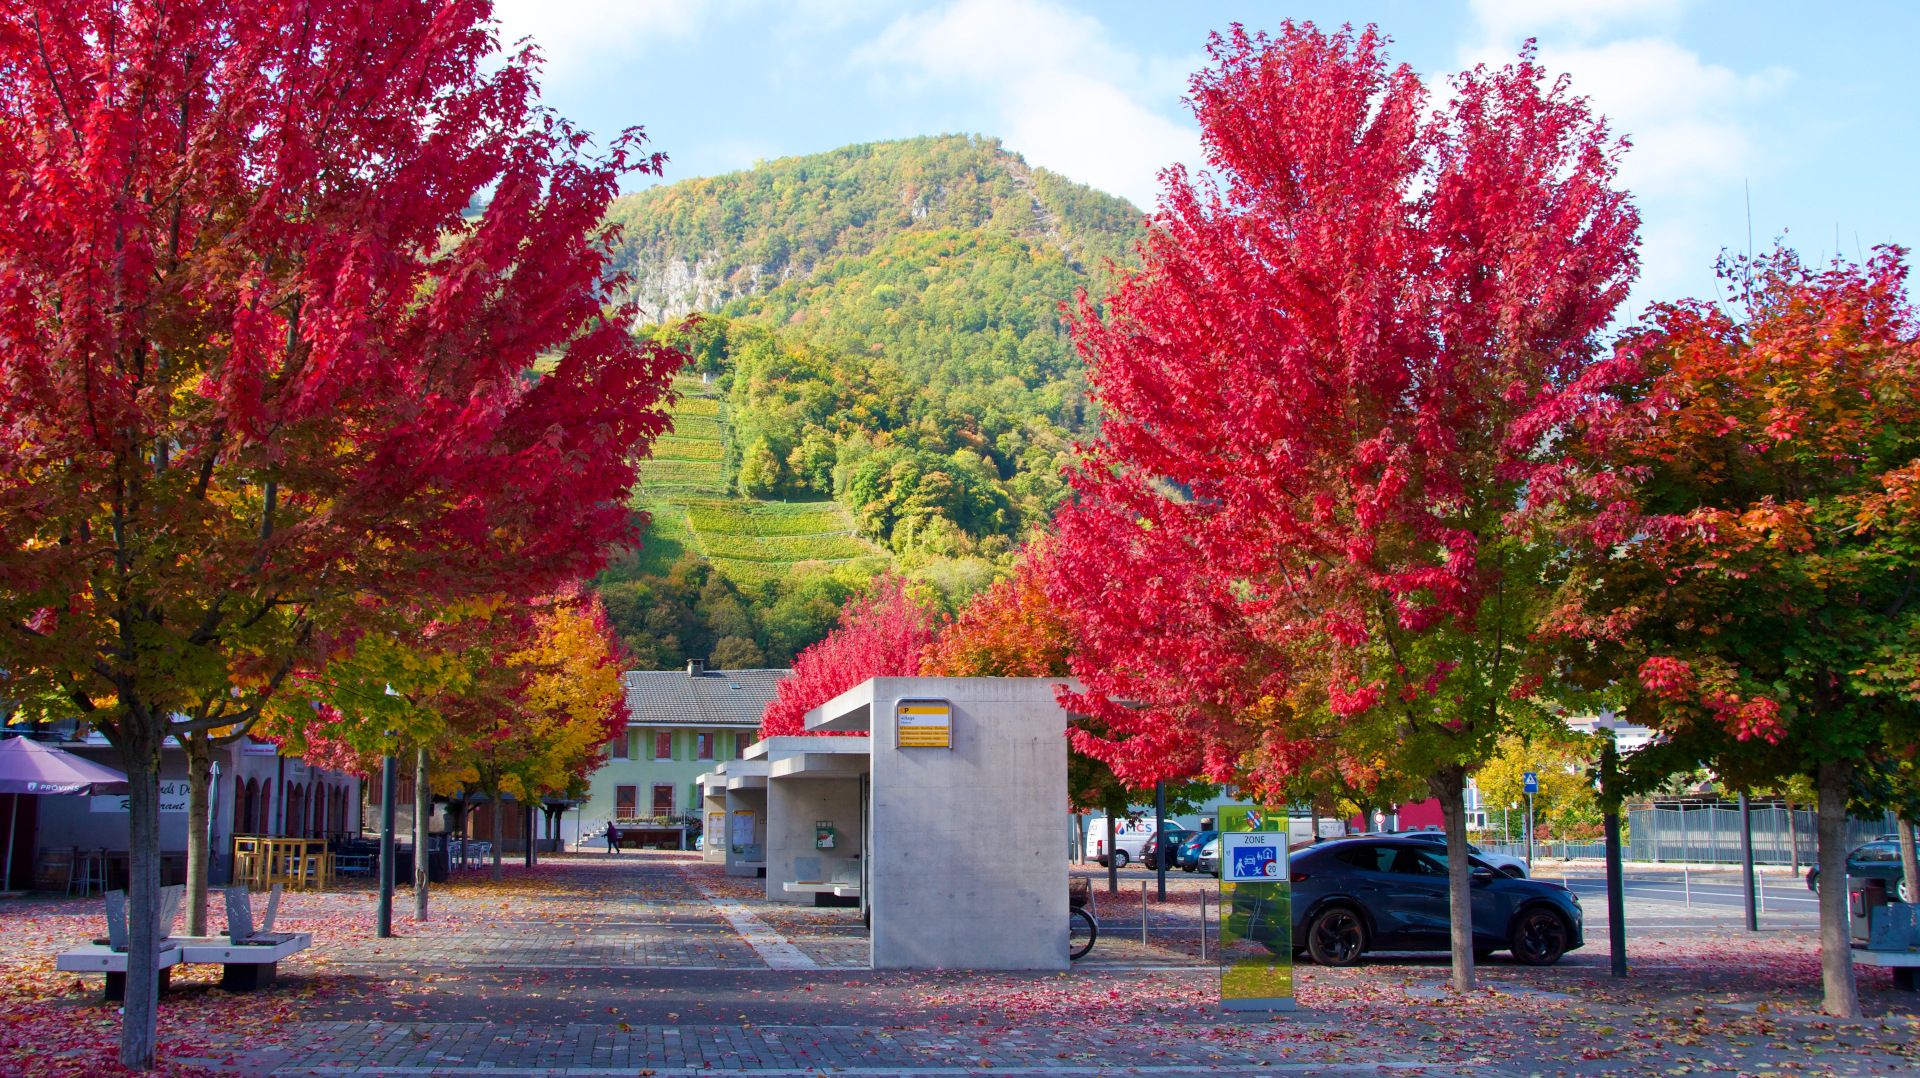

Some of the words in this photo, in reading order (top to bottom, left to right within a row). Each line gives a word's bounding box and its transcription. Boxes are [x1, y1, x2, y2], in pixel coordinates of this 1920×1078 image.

[40, 784, 80, 792] PROVINS
[1125, 823, 1153, 833] MCS
[1244, 835, 1265, 844] ZONE
[1268, 865, 1276, 873] 20
